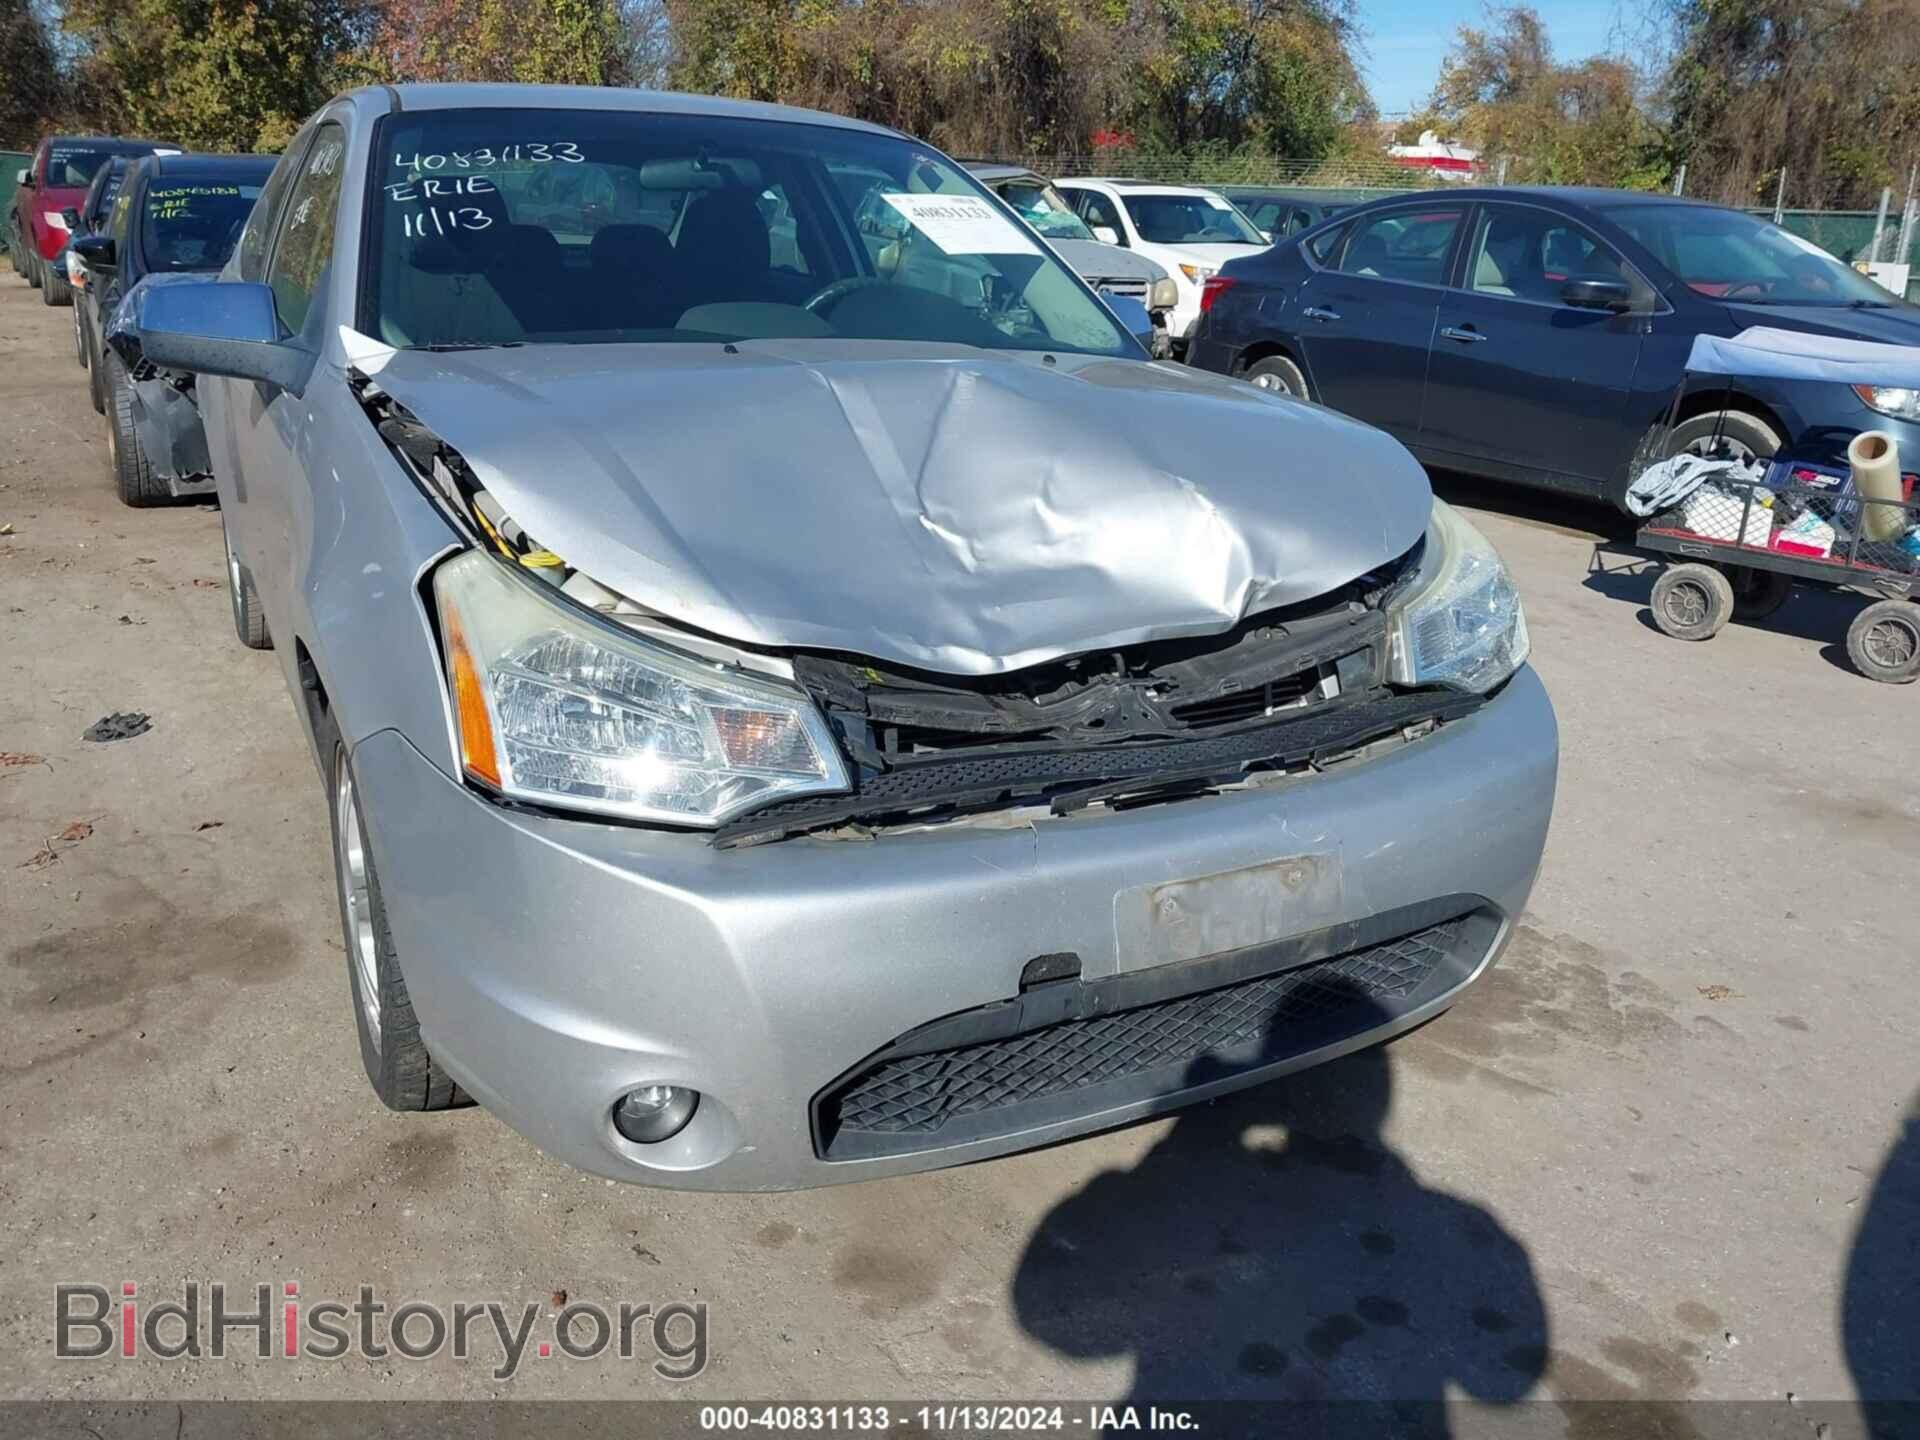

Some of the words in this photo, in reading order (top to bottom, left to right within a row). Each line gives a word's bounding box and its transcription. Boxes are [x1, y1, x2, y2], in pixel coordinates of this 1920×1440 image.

[395, 142, 586, 171] 40831133
[384, 174, 496, 202] ERIE
[403, 205, 494, 238] 11/13
[911, 206, 992, 220] 40831133
